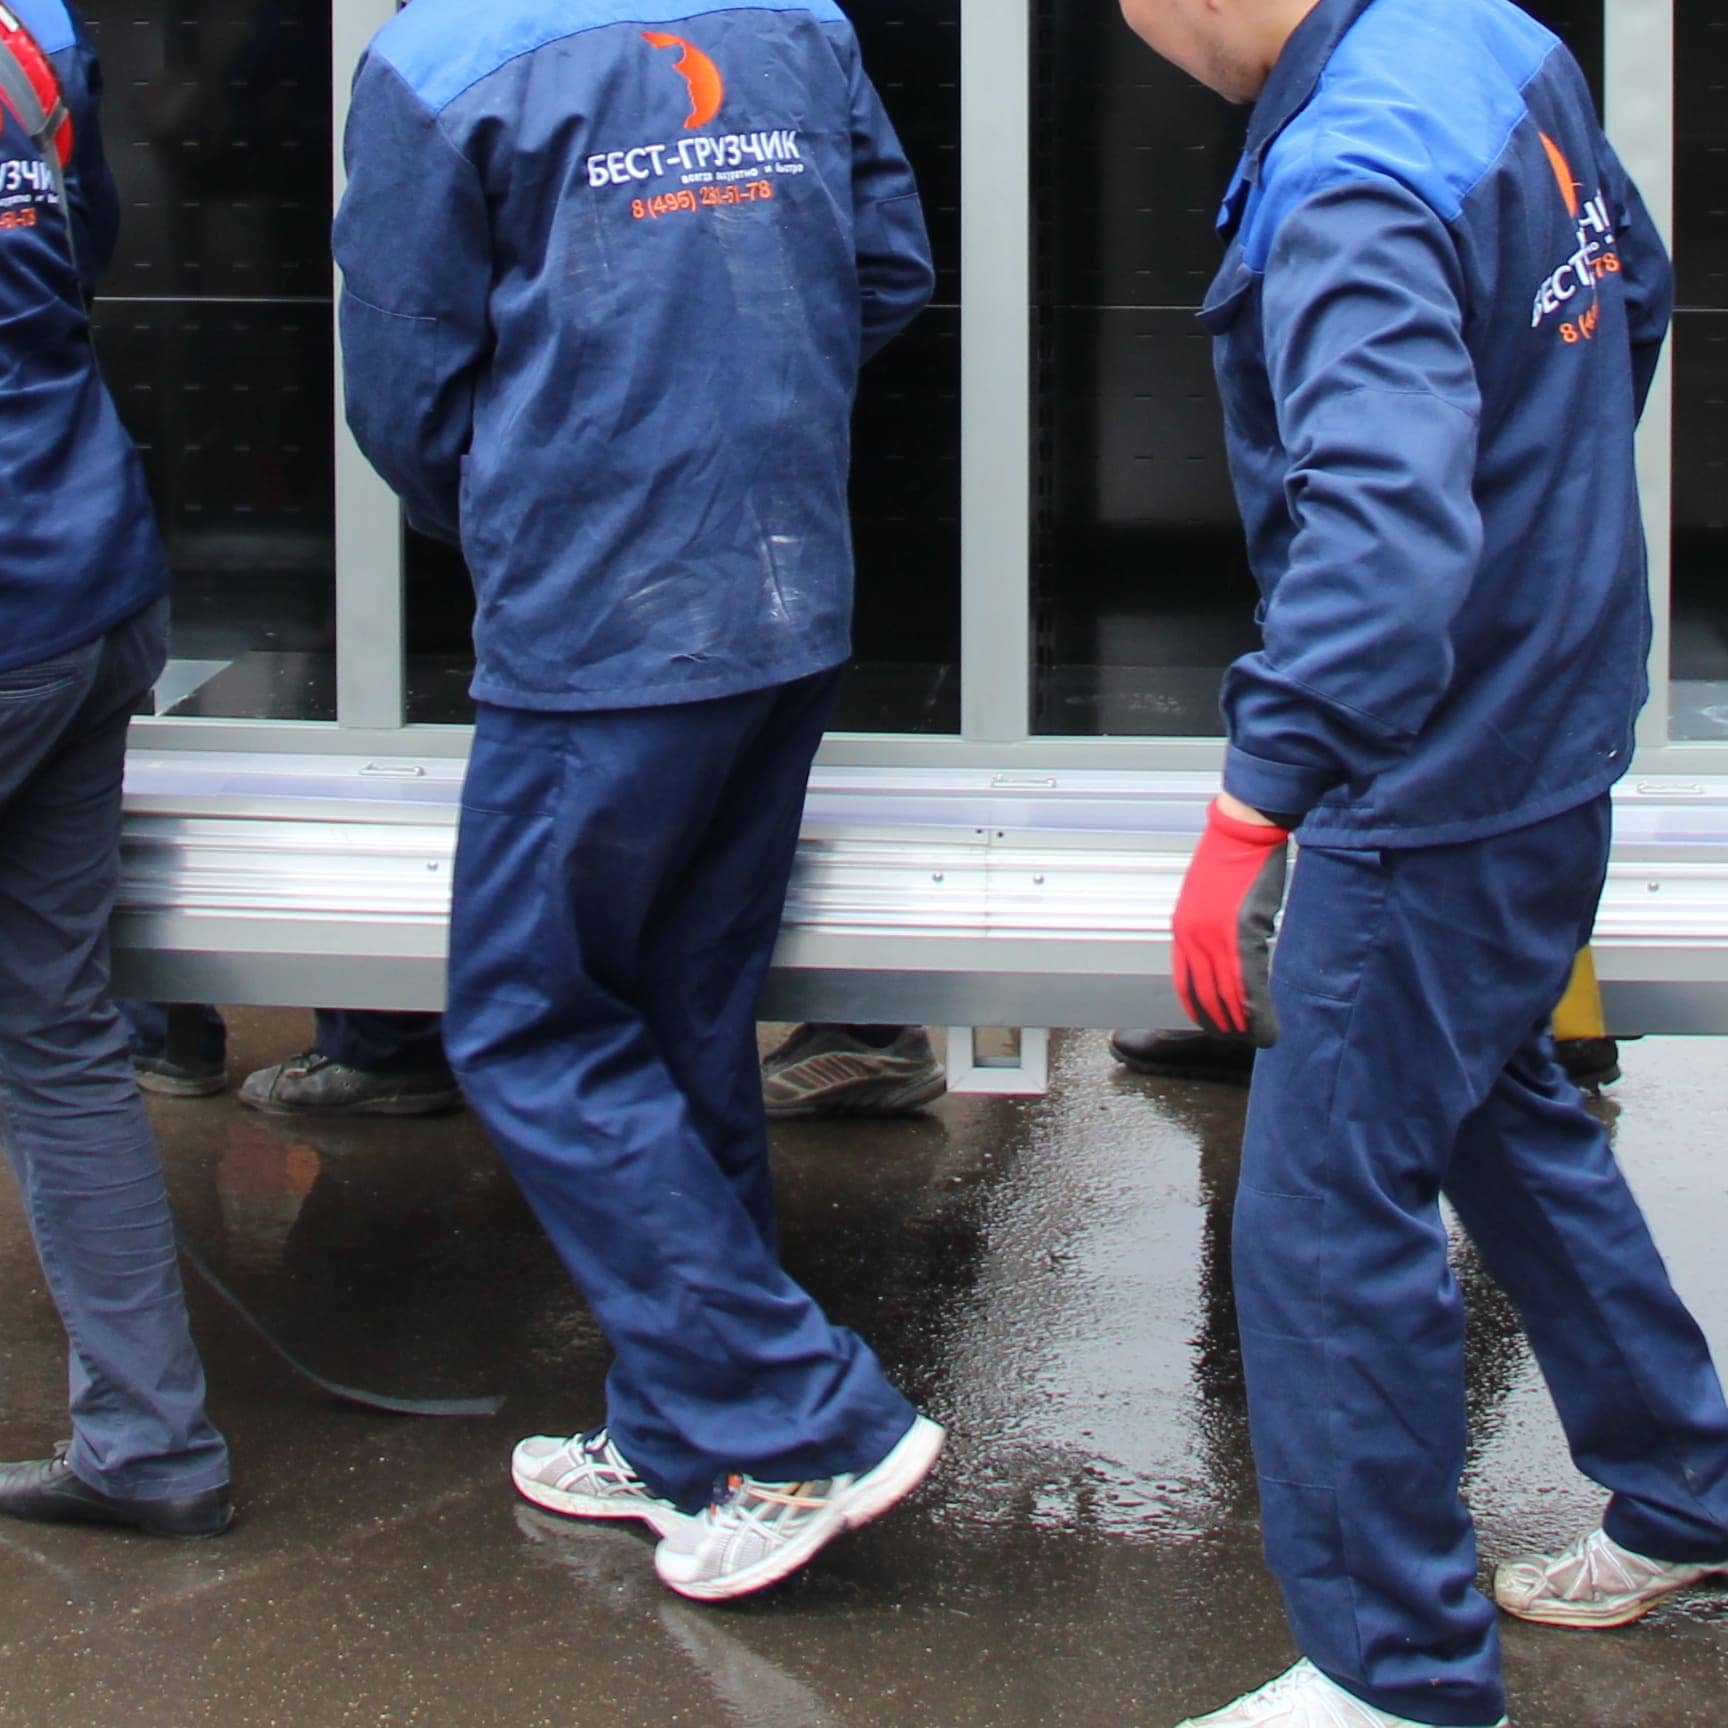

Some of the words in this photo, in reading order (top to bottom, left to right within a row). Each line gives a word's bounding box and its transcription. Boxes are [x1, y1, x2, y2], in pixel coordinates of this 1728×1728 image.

[587, 130, 801, 187] БЕСТ-ГРУЗЧИК
[631, 199, 645, 219] 8
[648, 190, 696, 220] (495)
